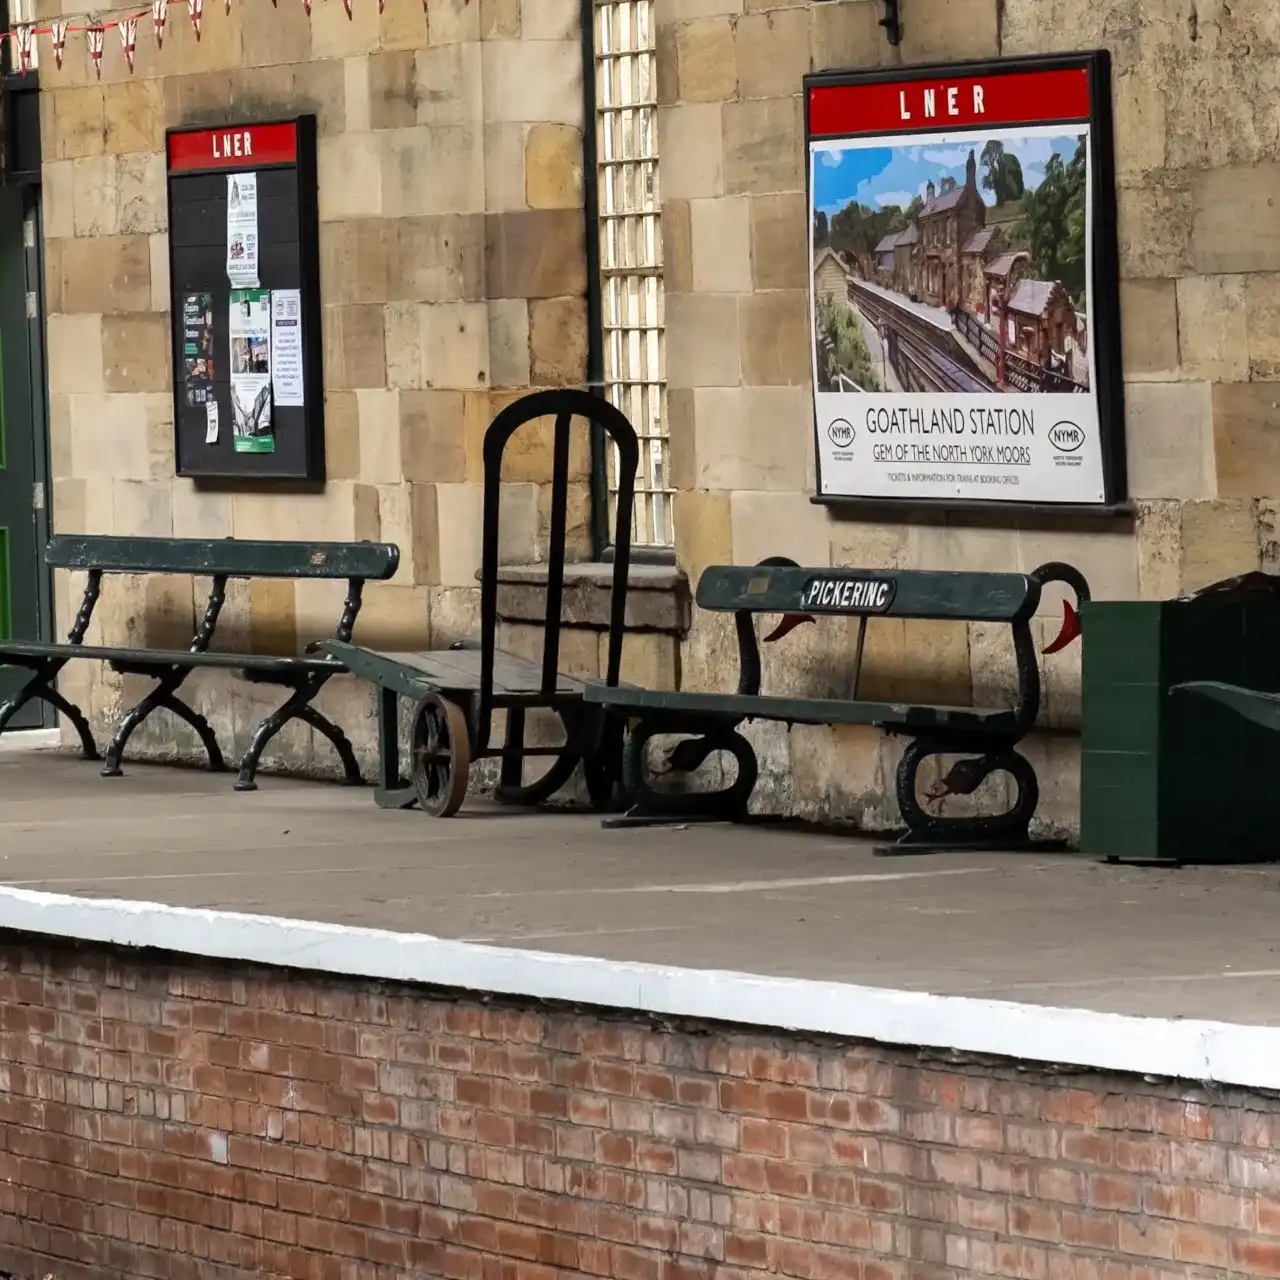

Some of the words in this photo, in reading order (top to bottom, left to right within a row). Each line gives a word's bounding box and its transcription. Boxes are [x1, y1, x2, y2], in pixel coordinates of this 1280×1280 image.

[899, 84, 985, 120] LNER
[212, 131, 253, 159] LNER
[866, 407, 965, 434] GOATHLAND
[969, 408, 1035, 435] STATION
[832, 426, 851, 439] NYMR
[1054, 429, 1080, 443] NYMR
[873, 444, 893, 460] GEM
[895, 444, 908, 460] OF
[911, 444, 930, 461] THE
[933, 445, 967, 461] NORTH
[970, 445, 994, 462] YORK
[997, 446, 1031, 463] MOORS
[887, 472, 906, 482] TICKETS
[912, 473, 945, 483] INFORMATION
[946, 474, 955, 483] FOR
[956, 474, 972, 483] TRAINS
[980, 474, 1001, 484] BOOKING
[1002, 475, 1020, 485] OFFICES
